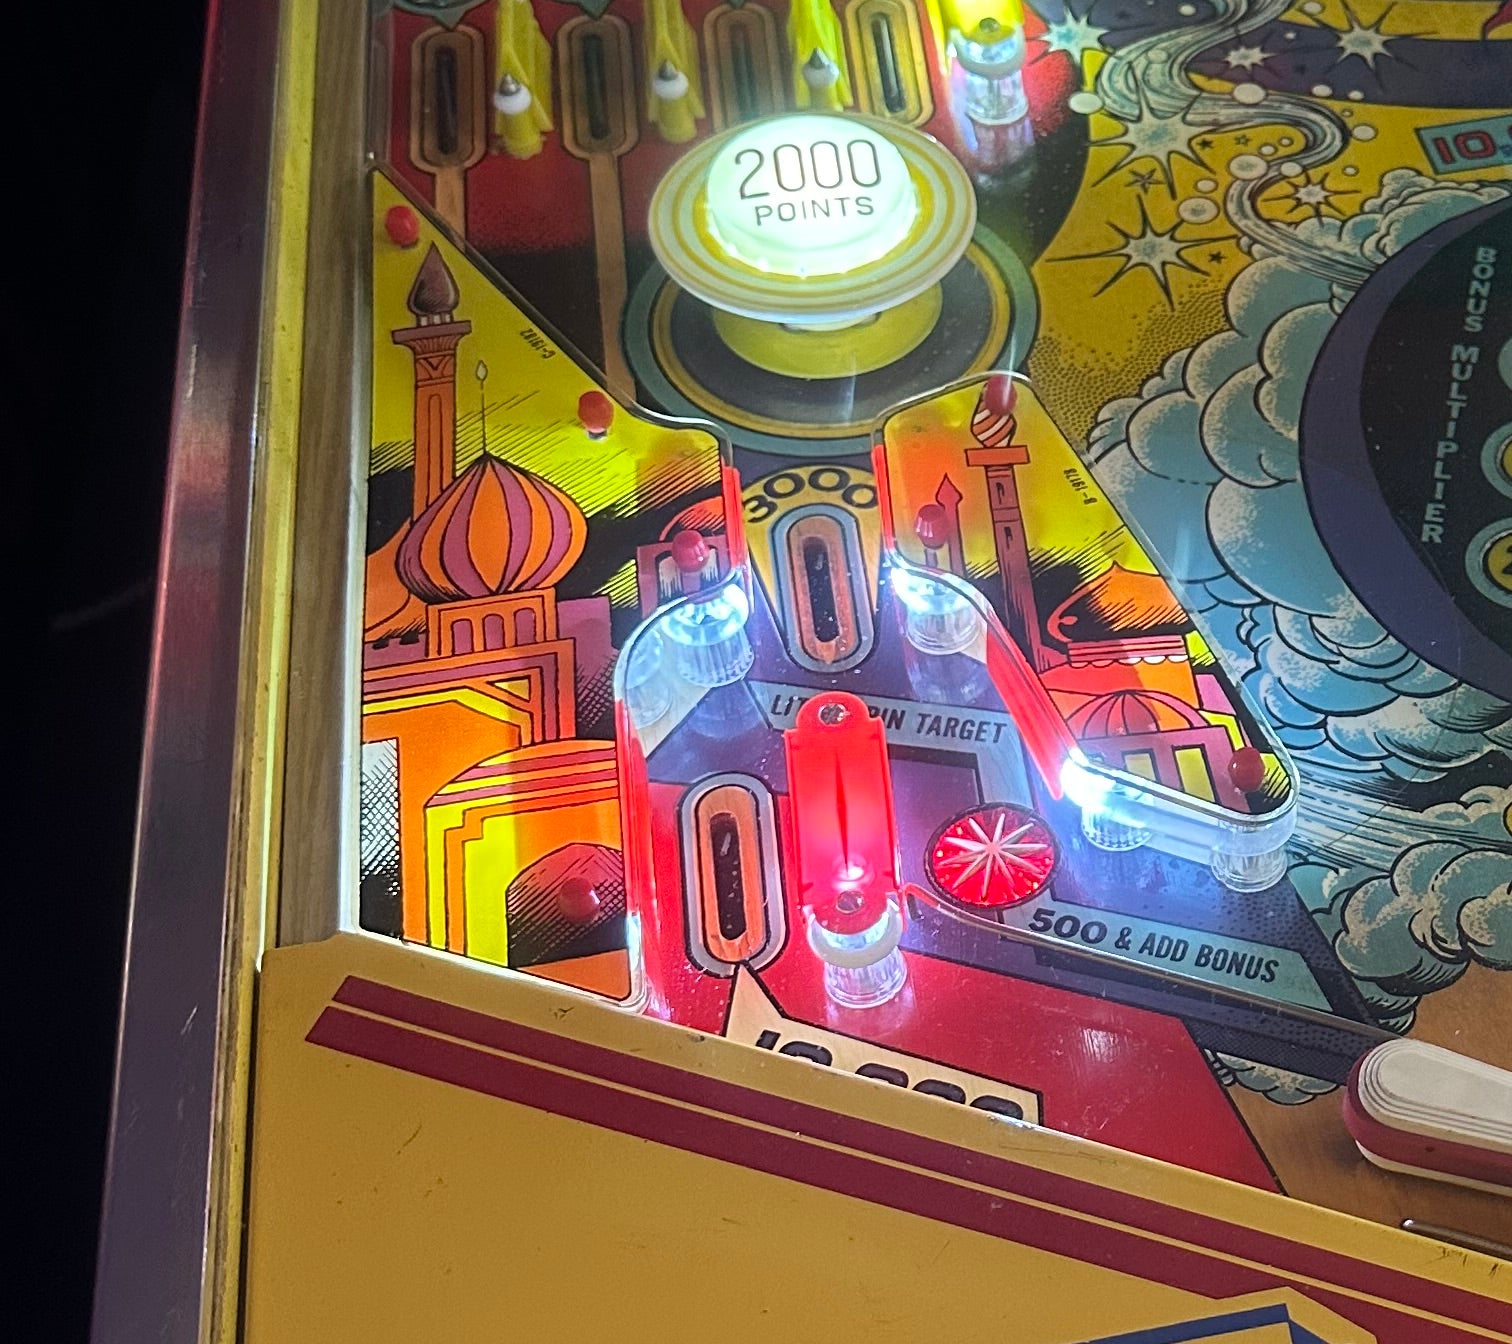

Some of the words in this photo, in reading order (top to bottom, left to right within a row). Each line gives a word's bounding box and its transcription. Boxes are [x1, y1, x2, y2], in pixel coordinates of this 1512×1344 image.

[734, 138, 882, 201] 2000
[754, 195, 875, 227] POINTS
[1463, 245, 1498, 334] BONUS
[1421, 343, 1482, 544] MULTIPLIER
[743, 467, 880, 524] 3000
[915, 711, 1008, 745] TARGET
[1027, 906, 1108, 946] 500
[1116, 926, 1133, 951] &
[1137, 930, 1189, 964] ADD
[1194, 944, 1281, 984] BONUS
